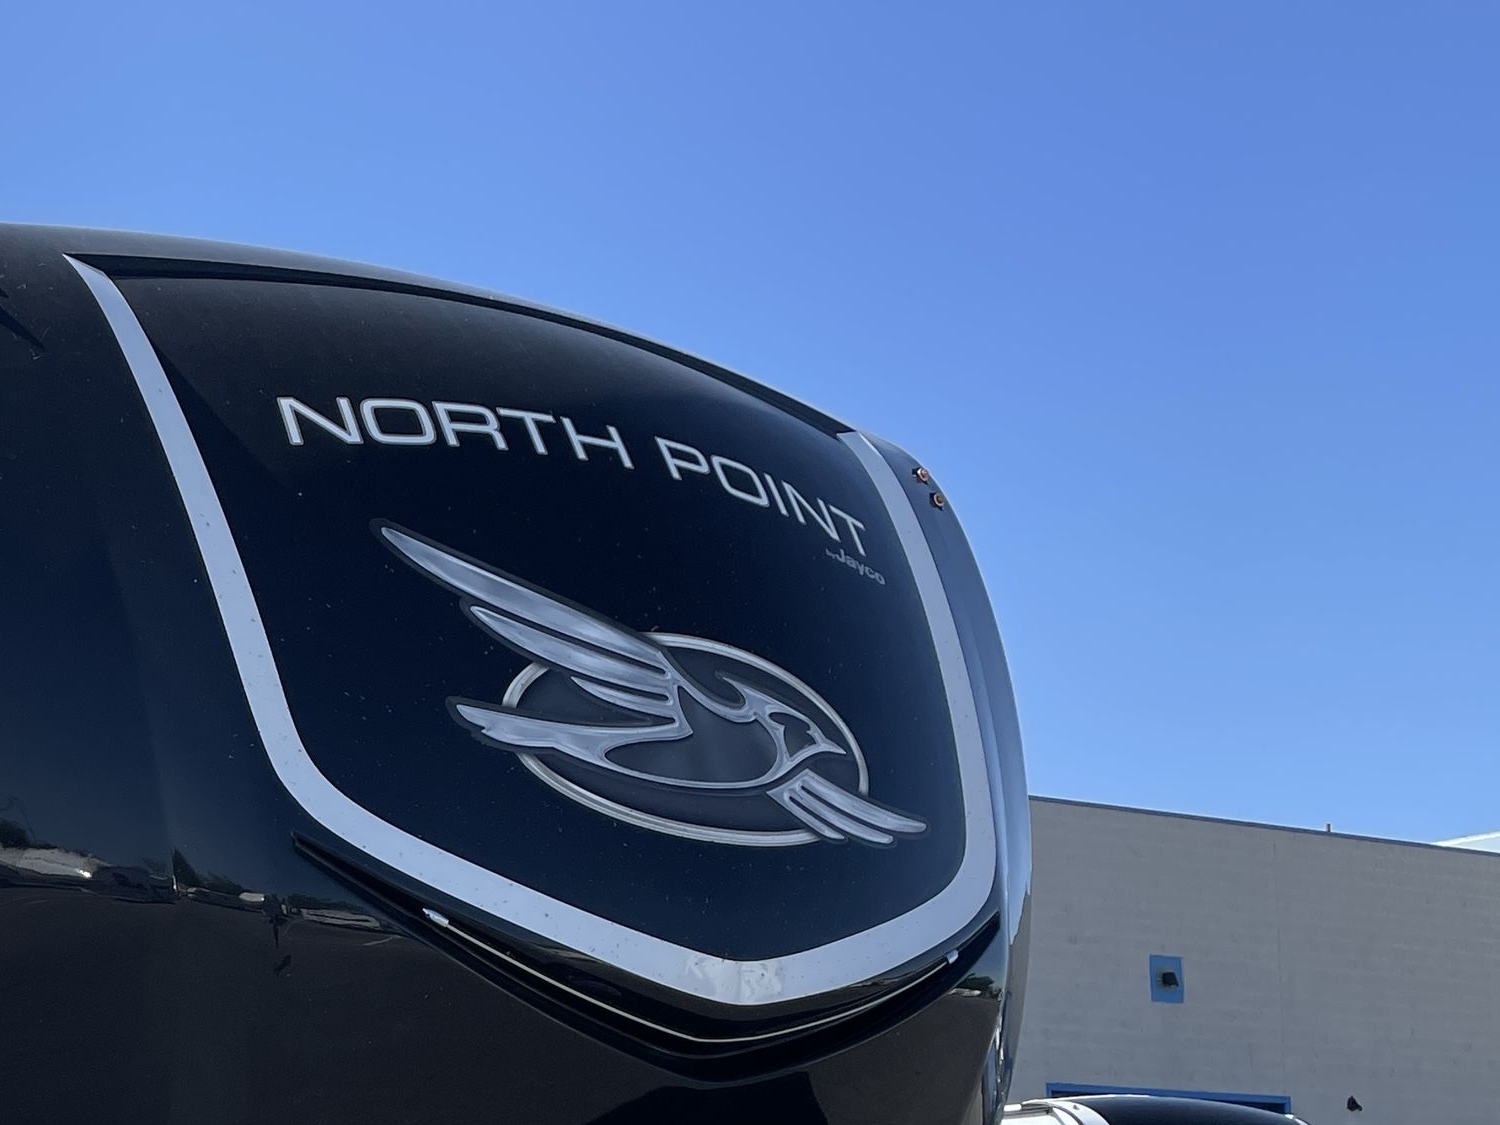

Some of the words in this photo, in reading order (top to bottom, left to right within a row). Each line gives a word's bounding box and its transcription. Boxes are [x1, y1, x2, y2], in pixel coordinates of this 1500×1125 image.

[278, 396, 633, 470] NORTH
[656, 436, 867, 558] POINT
[838, 548, 886, 585] Jayco
